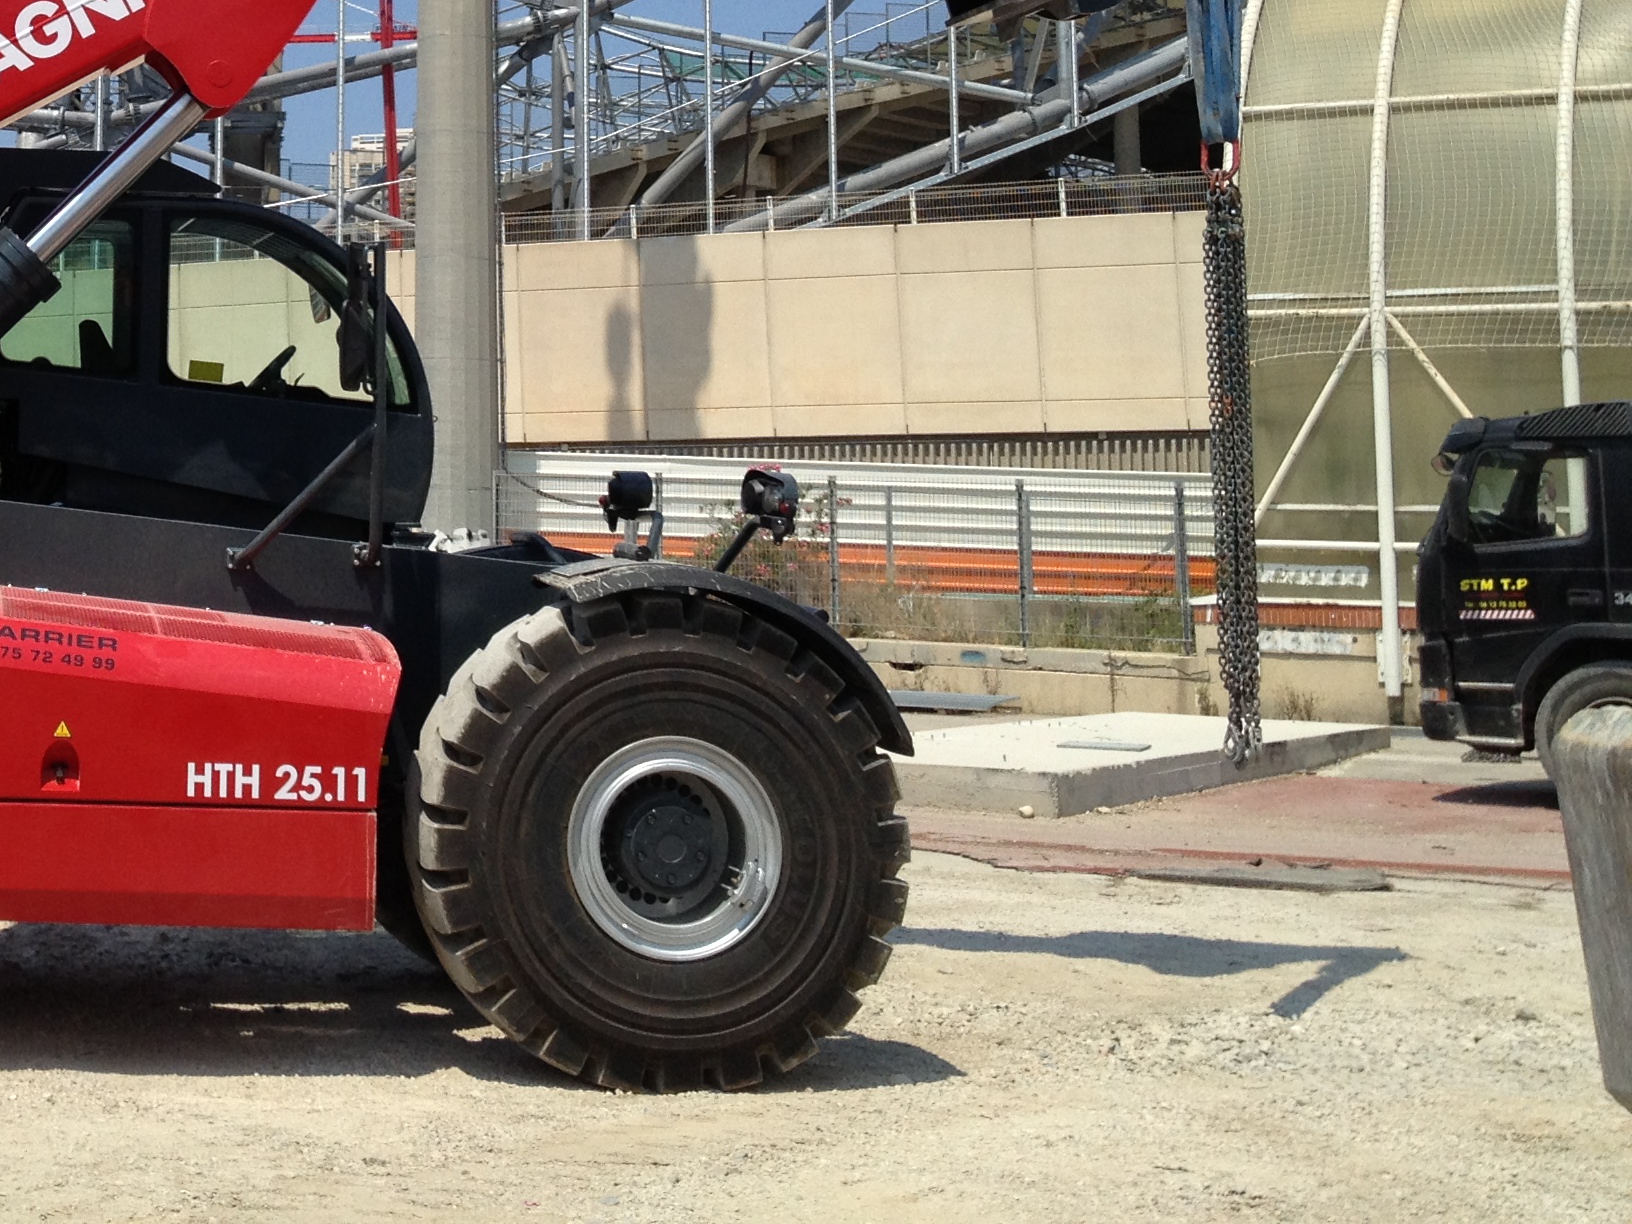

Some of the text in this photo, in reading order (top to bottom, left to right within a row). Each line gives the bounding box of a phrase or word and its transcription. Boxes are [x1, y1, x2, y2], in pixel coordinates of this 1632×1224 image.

[0, 646, 22, 660] 75
[31, 650, 53, 663] 72
[61, 654, 84, 667] 49
[92, 656, 115, 670] 99
[187, 762, 366, 802] HTH 25.11
